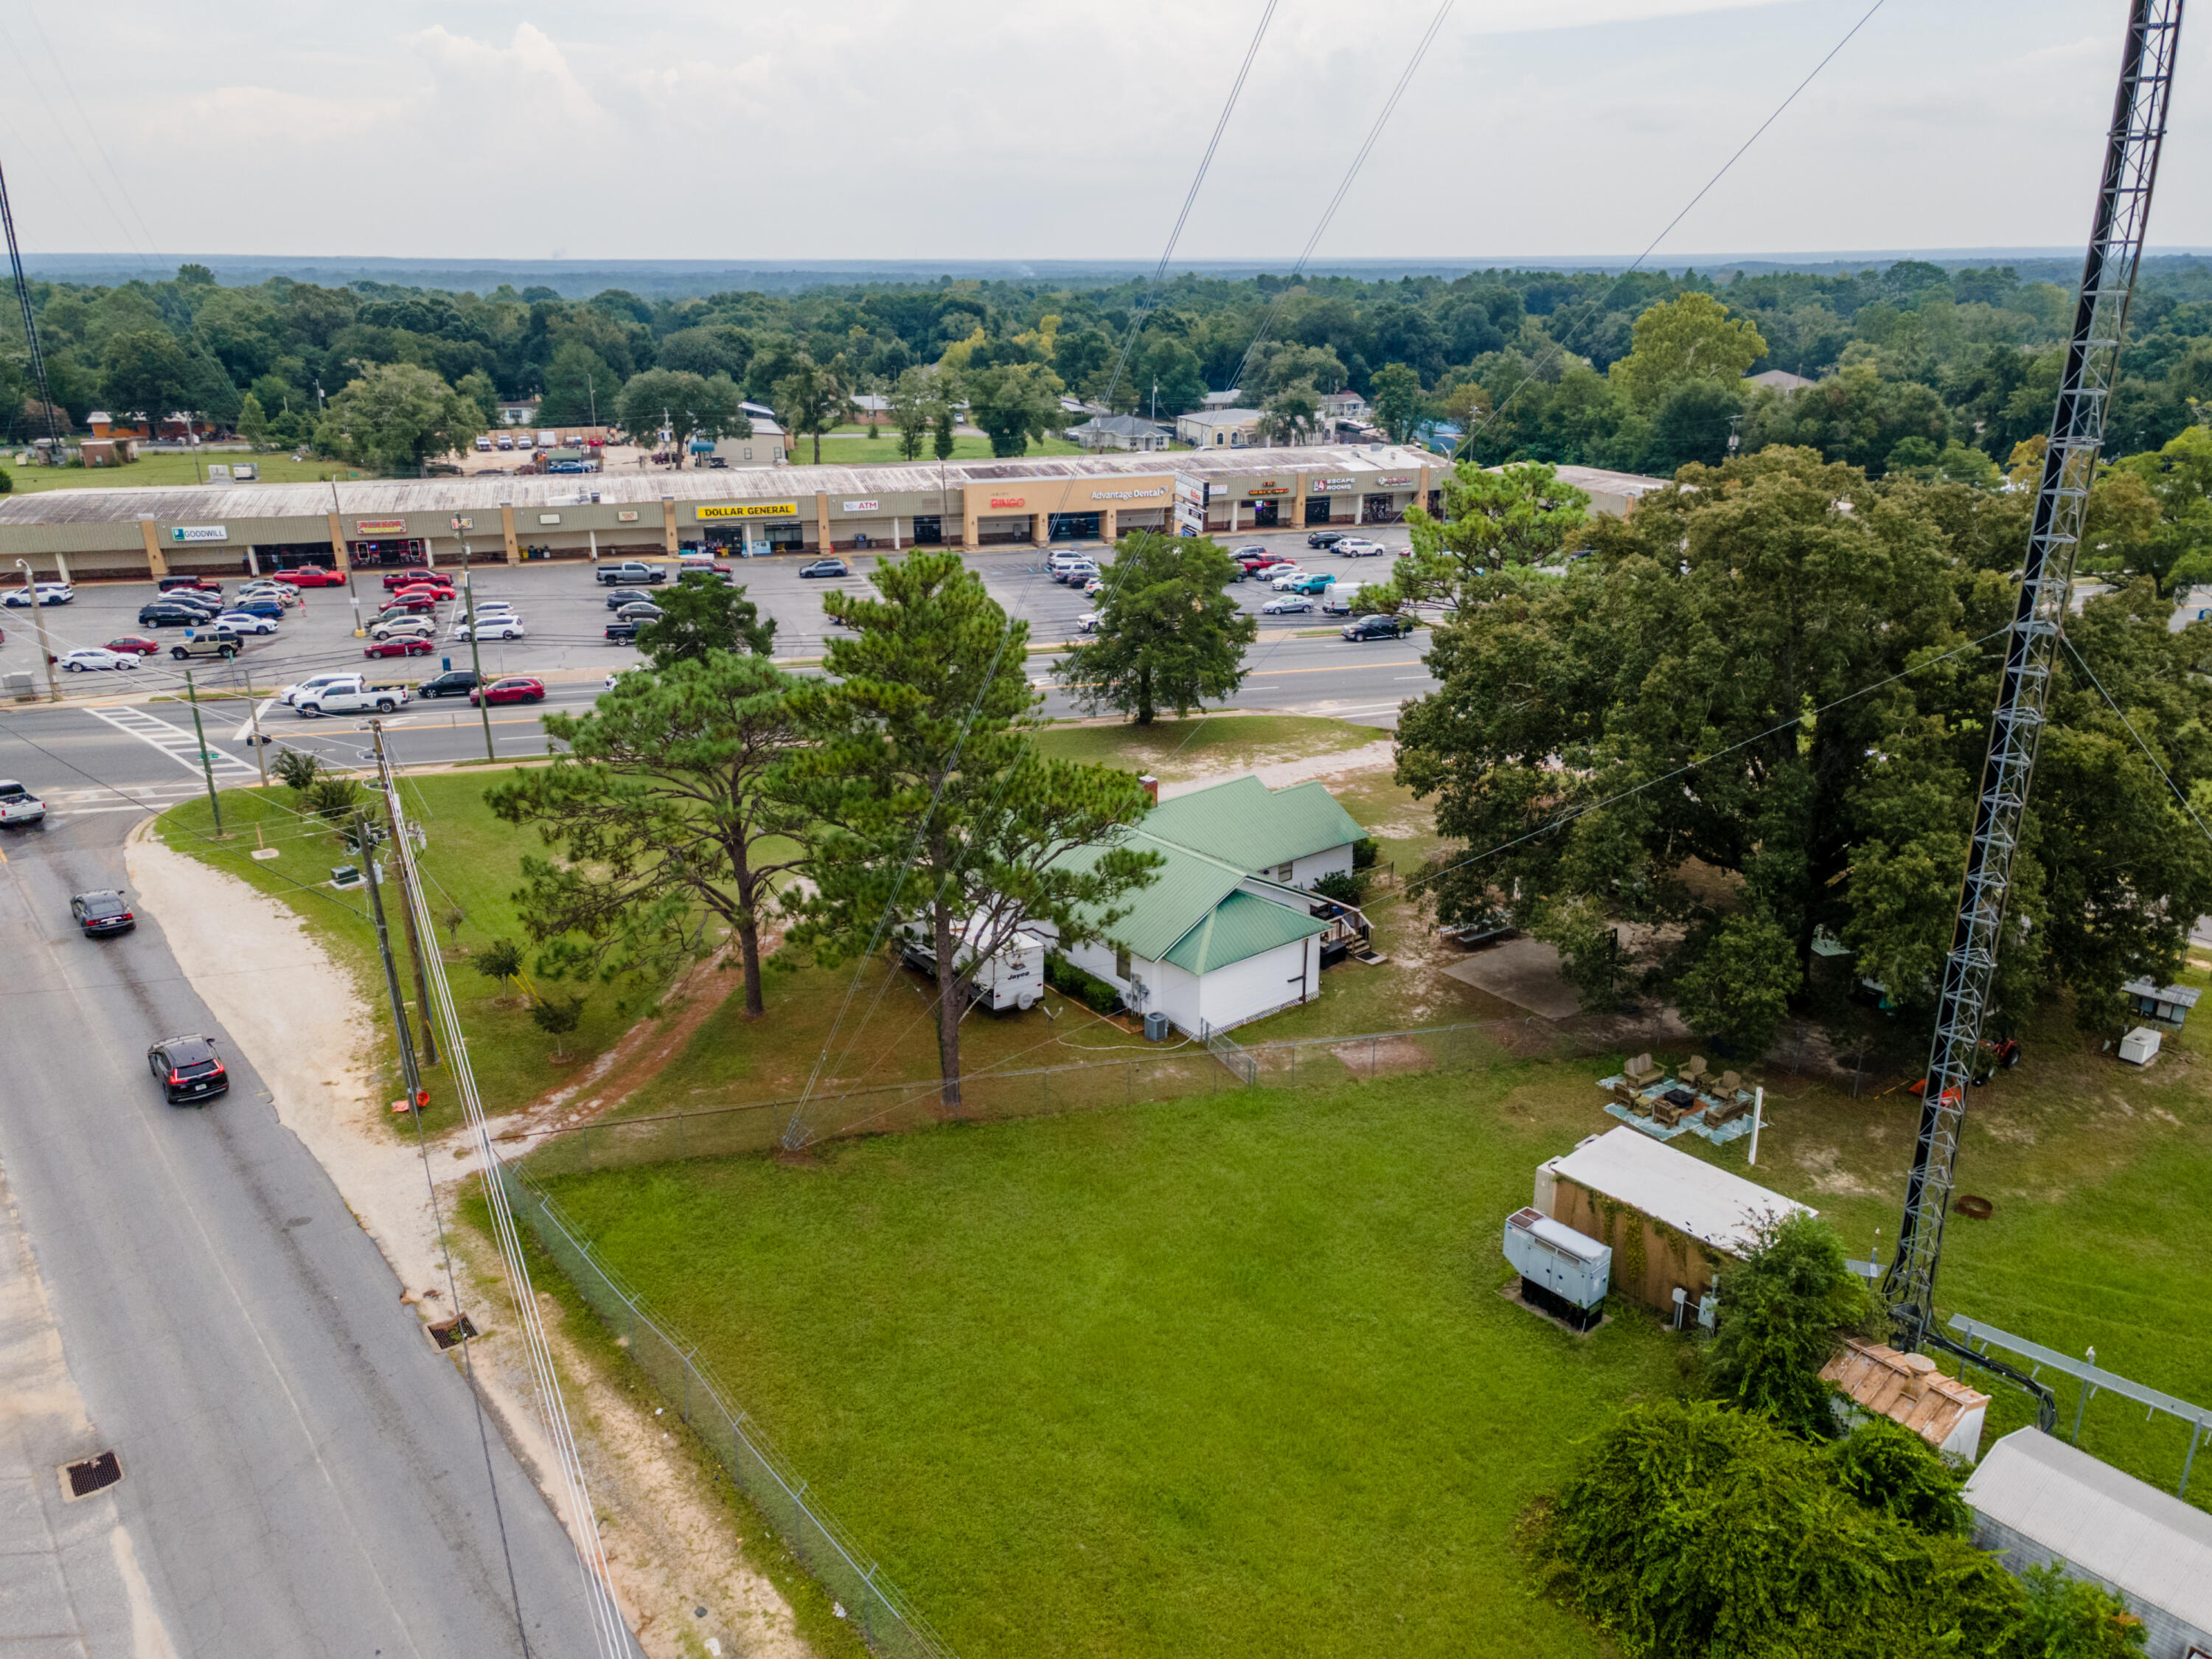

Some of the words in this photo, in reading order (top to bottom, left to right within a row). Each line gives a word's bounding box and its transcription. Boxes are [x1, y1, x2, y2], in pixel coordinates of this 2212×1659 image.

[1092, 492, 1133, 500] Advantage
[991, 498, 1026, 507] BINGO
[704, 507, 743, 516] DOLLAR
[747, 505, 791, 515] GENERAL
[1008, 971, 1029, 981] Jayco
